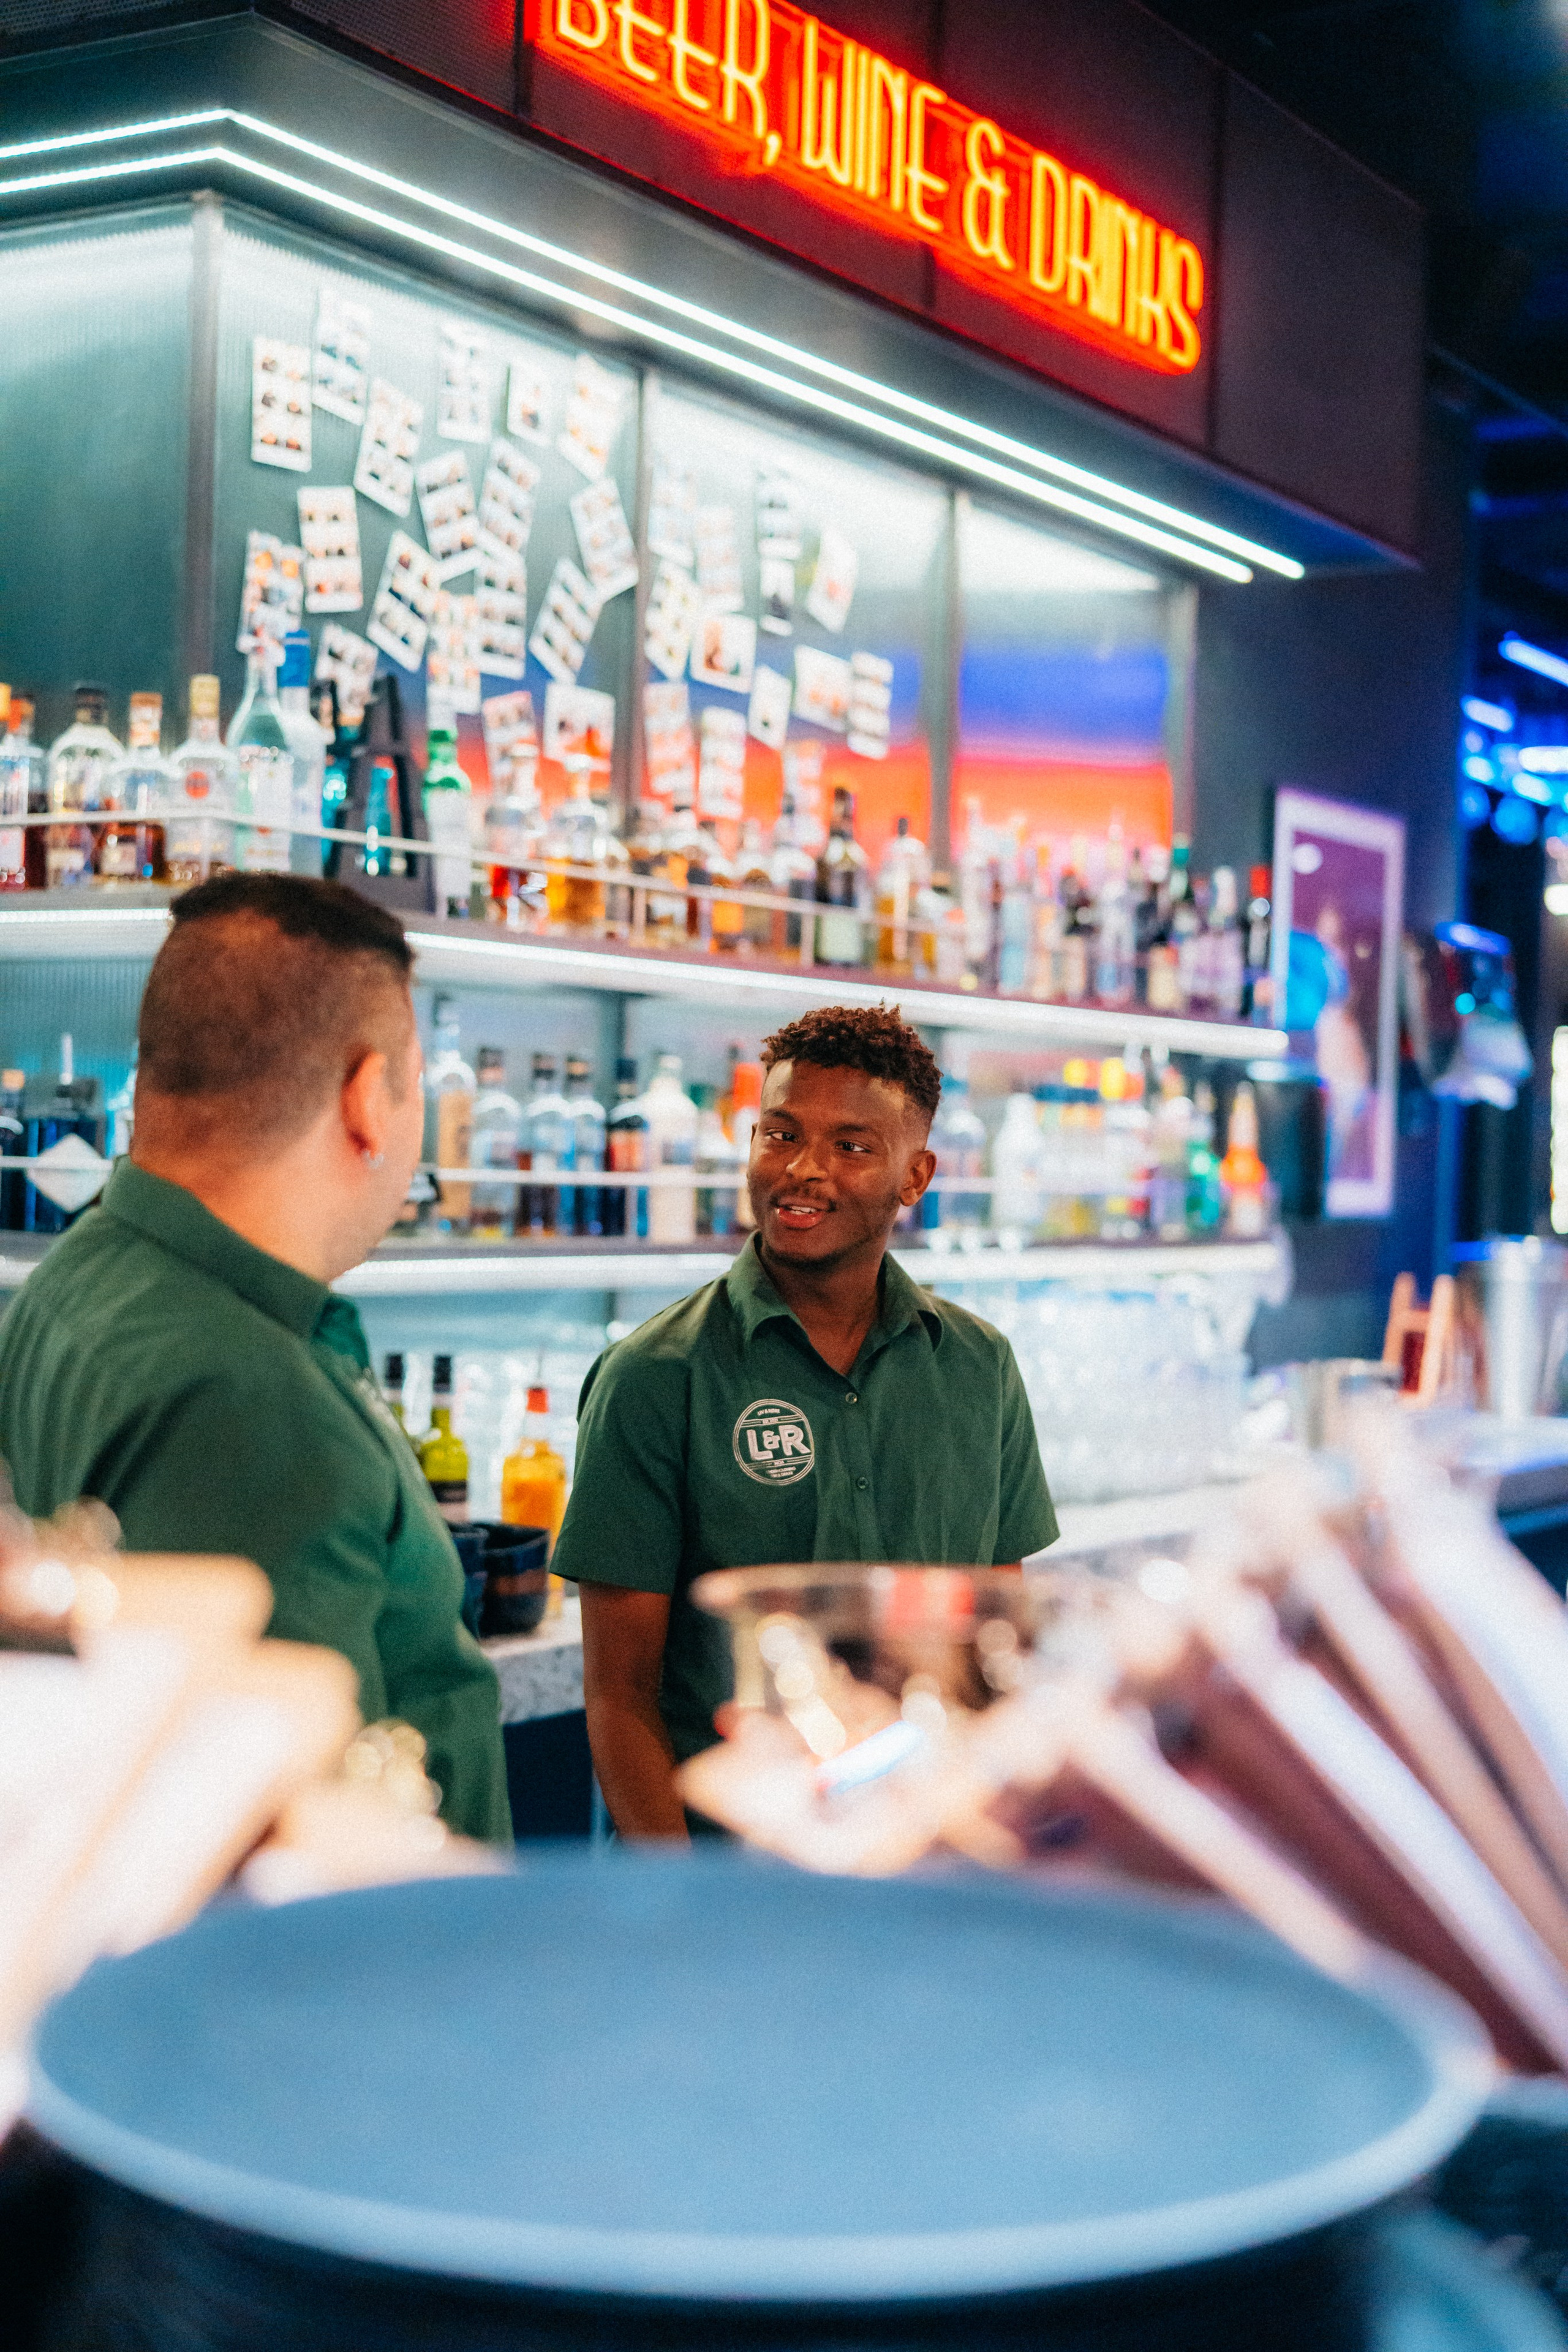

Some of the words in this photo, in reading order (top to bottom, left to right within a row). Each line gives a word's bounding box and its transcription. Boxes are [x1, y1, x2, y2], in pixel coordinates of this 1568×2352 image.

[557, 0, 782, 166] ER,
[801, 17, 948, 232] WINE
[962, 118, 1016, 270] &
[1030, 154, 1204, 367] DRINKS
[747, 1425, 811, 1460] L&R
